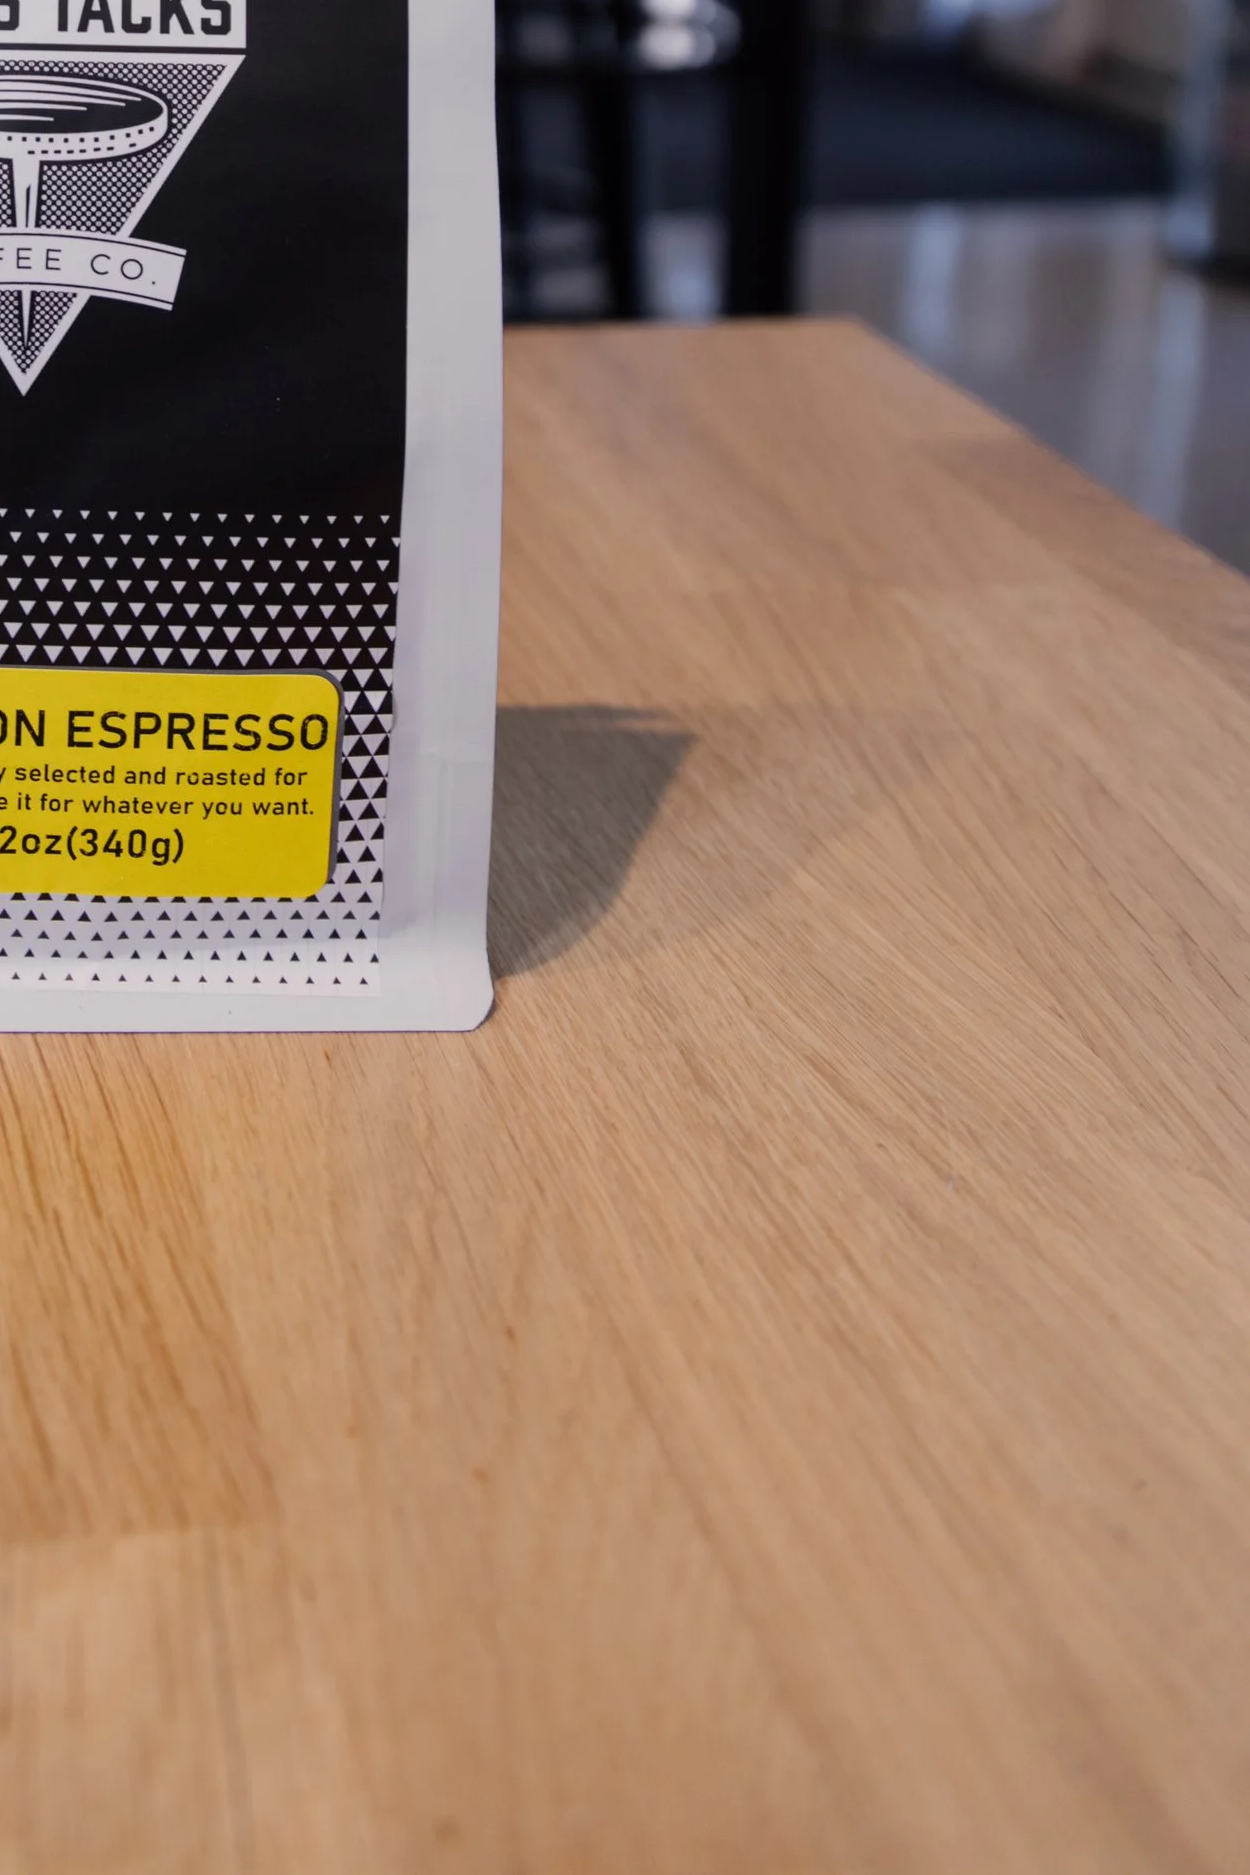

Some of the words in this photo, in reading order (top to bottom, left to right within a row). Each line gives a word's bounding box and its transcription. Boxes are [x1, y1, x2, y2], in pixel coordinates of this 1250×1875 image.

[90, 253, 156, 285] CO.
[67, 710, 329, 752] ESPRESSO
[14, 763, 116, 785] selected
[124, 766, 166, 786] and
[175, 768, 266, 787] roasted
[274, 768, 308, 786] for
[17, 792, 32, 811] it
[40, 793, 74, 813] for
[82, 795, 194, 816] whatever
[202, 801, 243, 820] you
[252, 801, 314, 816] want.
